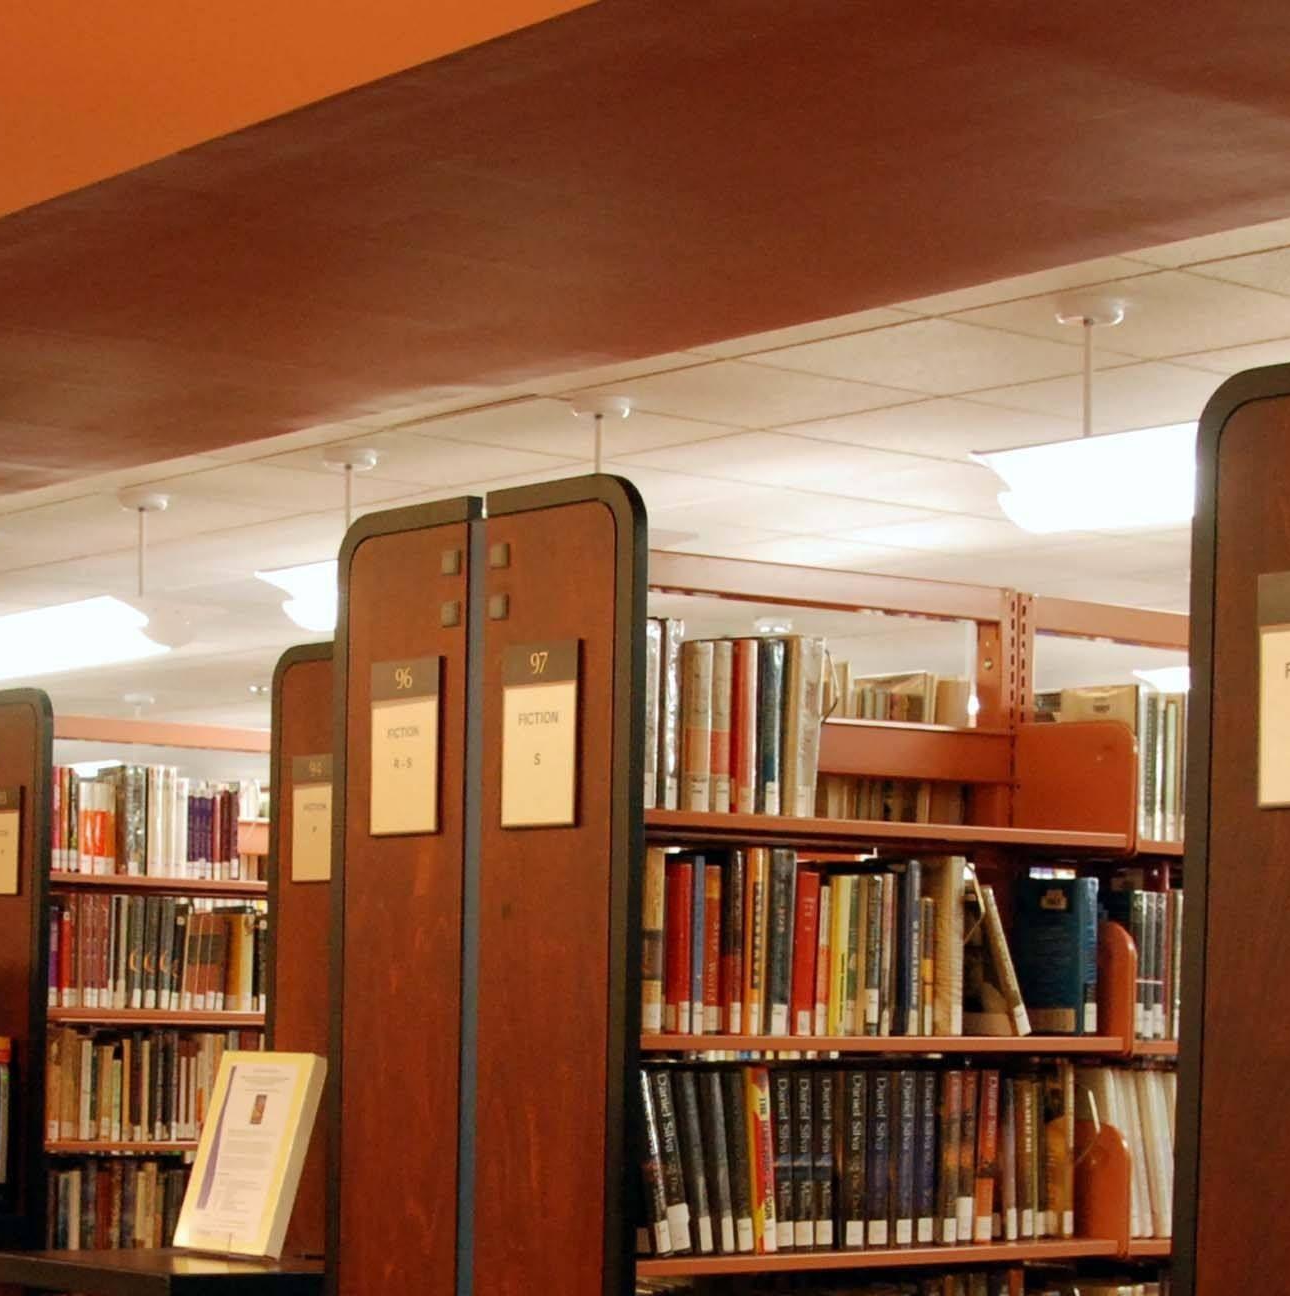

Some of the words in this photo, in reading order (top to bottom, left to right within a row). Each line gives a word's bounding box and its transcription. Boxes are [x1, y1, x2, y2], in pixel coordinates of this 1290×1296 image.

[530, 652, 548, 674] 97
[395, 667, 413, 689] 96
[386, 725, 420, 740] FICTION
[517, 711, 559, 726] FICTION
[534, 752, 542, 766] S
[778, 1078, 790, 1120] Daniel
[799, 1078, 811, 1120] Daniel
[821, 1079, 832, 1120] Daniel
[852, 1074, 862, 1116] Daniel
[875, 1077, 886, 1118] Daniel
[902, 1077, 913, 1118] Daniel
[924, 1076, 934, 1117] Daniel
[656, 1073, 672, 1118] Daniel
[664, 1121, 676, 1153] Silva
[778, 1124, 790, 1153] Silva
[799, 1124, 811, 1152] Silva
[821, 1124, 832, 1153] Silva
[852, 1120, 862, 1150] Silva
[875, 1122, 886, 1150] Silva
[902, 1121, 913, 1150] Silva
[924, 1120, 934, 1149] Silva
